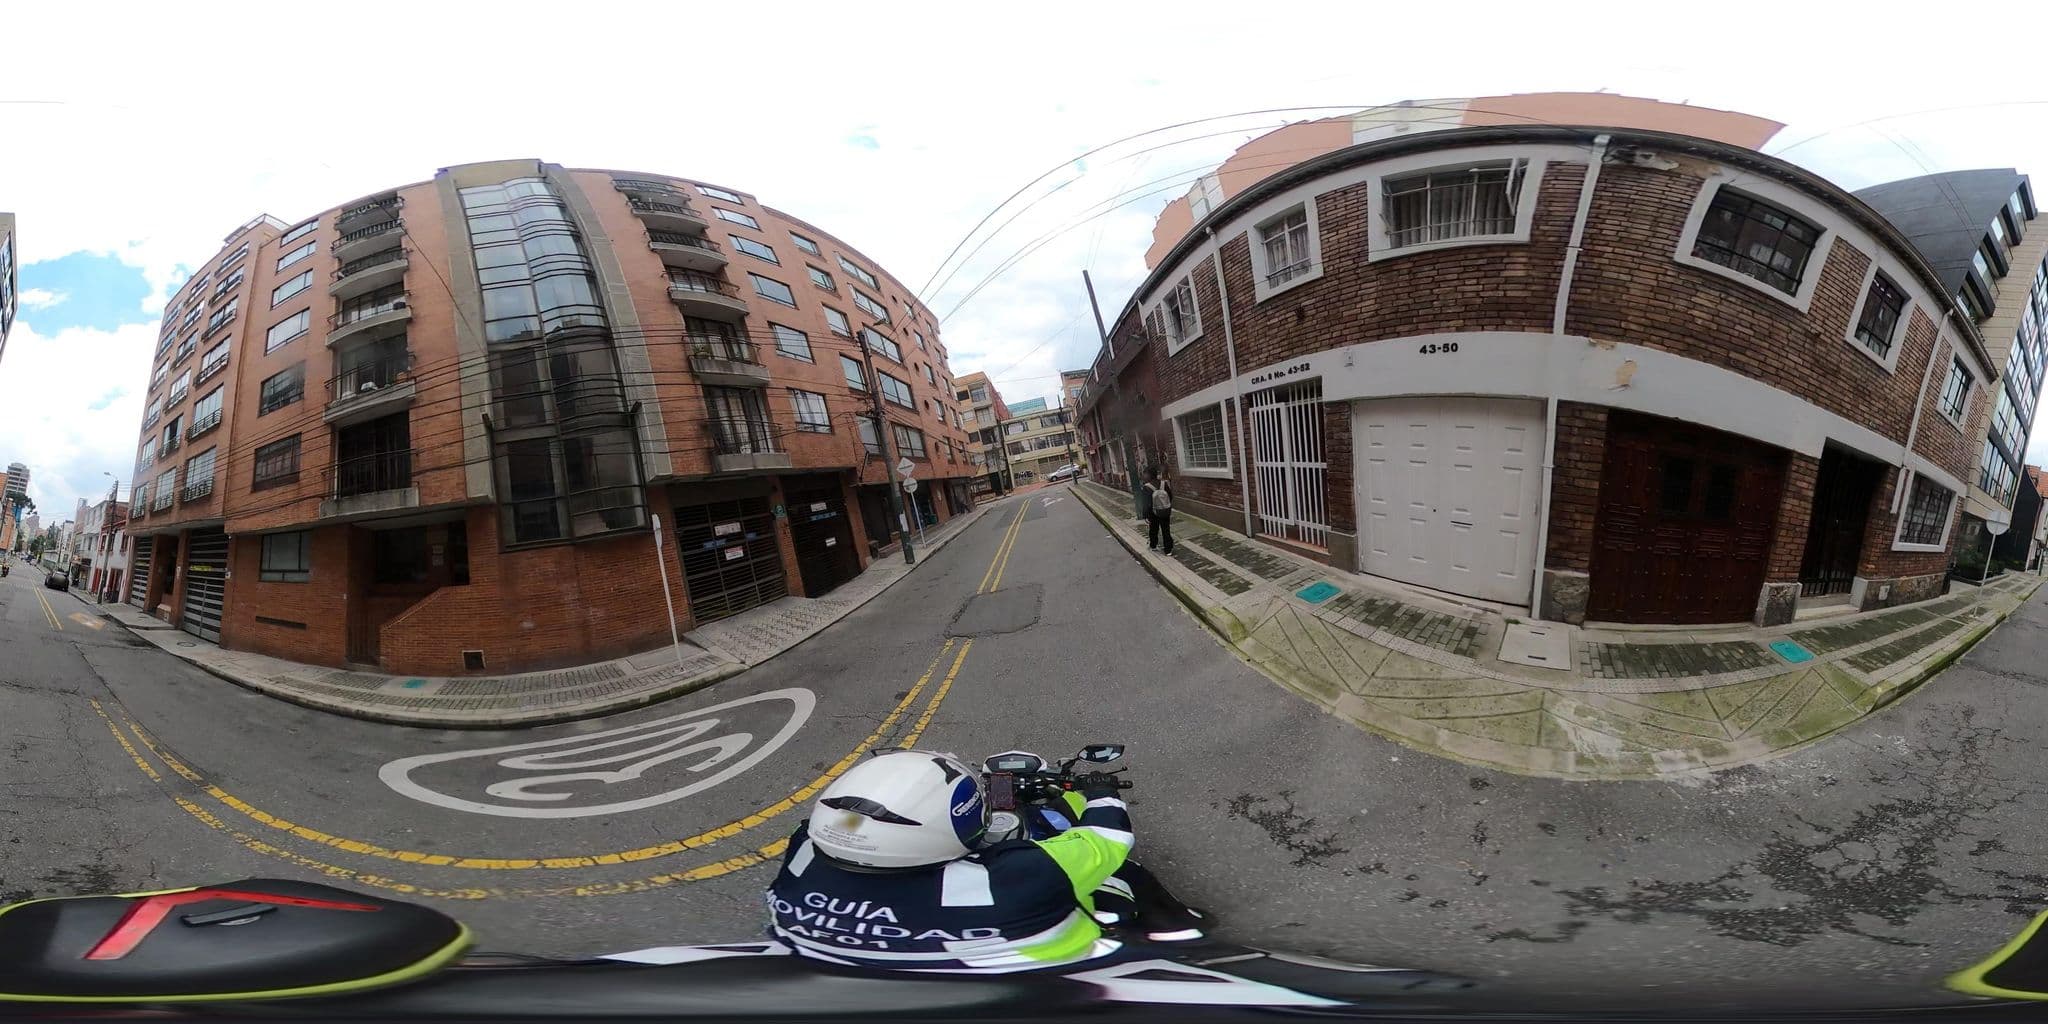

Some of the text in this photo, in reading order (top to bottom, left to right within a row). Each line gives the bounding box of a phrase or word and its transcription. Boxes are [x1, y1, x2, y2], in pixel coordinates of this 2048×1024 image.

[1419, 342, 1459, 354] 43-50
[1288, 362, 1310, 374] 43-52
[485, 718, 753, 800] 30
[766, 889, 1001, 940] MOVILIDAD
[803, 892, 898, 923] GUÍA
